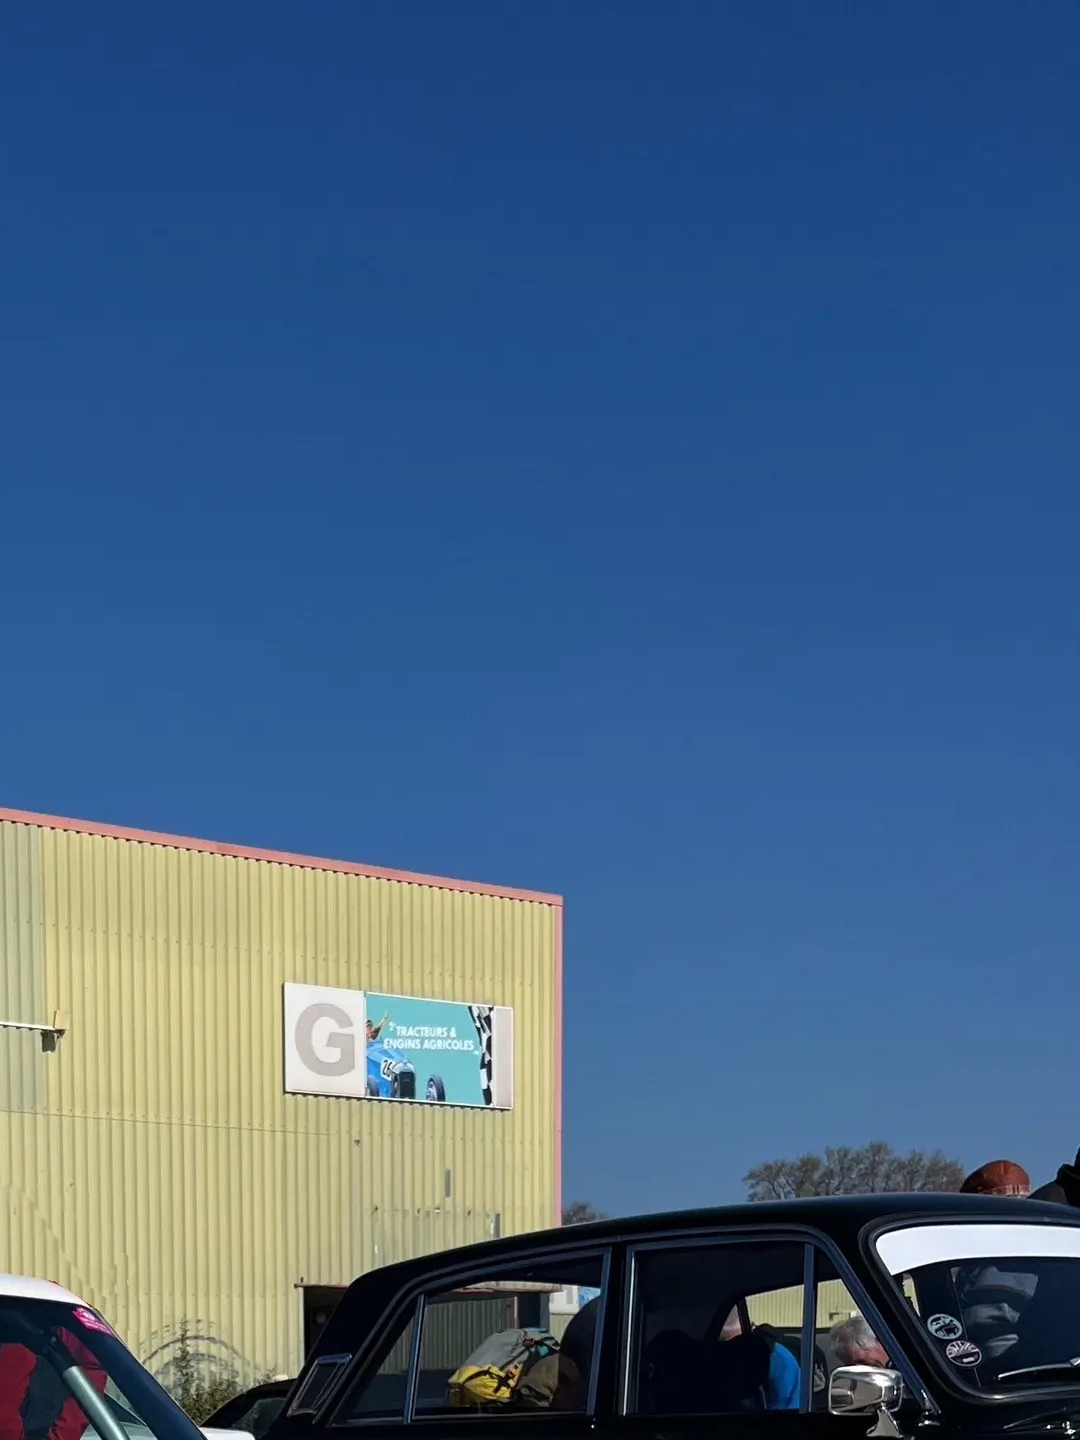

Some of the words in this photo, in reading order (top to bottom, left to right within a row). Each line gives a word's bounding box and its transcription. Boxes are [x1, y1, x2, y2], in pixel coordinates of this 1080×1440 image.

[395, 1025, 448, 1038] TRACTEURS
[449, 1027, 457, 1038] &
[294, 1002, 356, 1077] G
[383, 1038, 421, 1050] ENGINS
[422, 1039, 475, 1051] AGRICOLES
